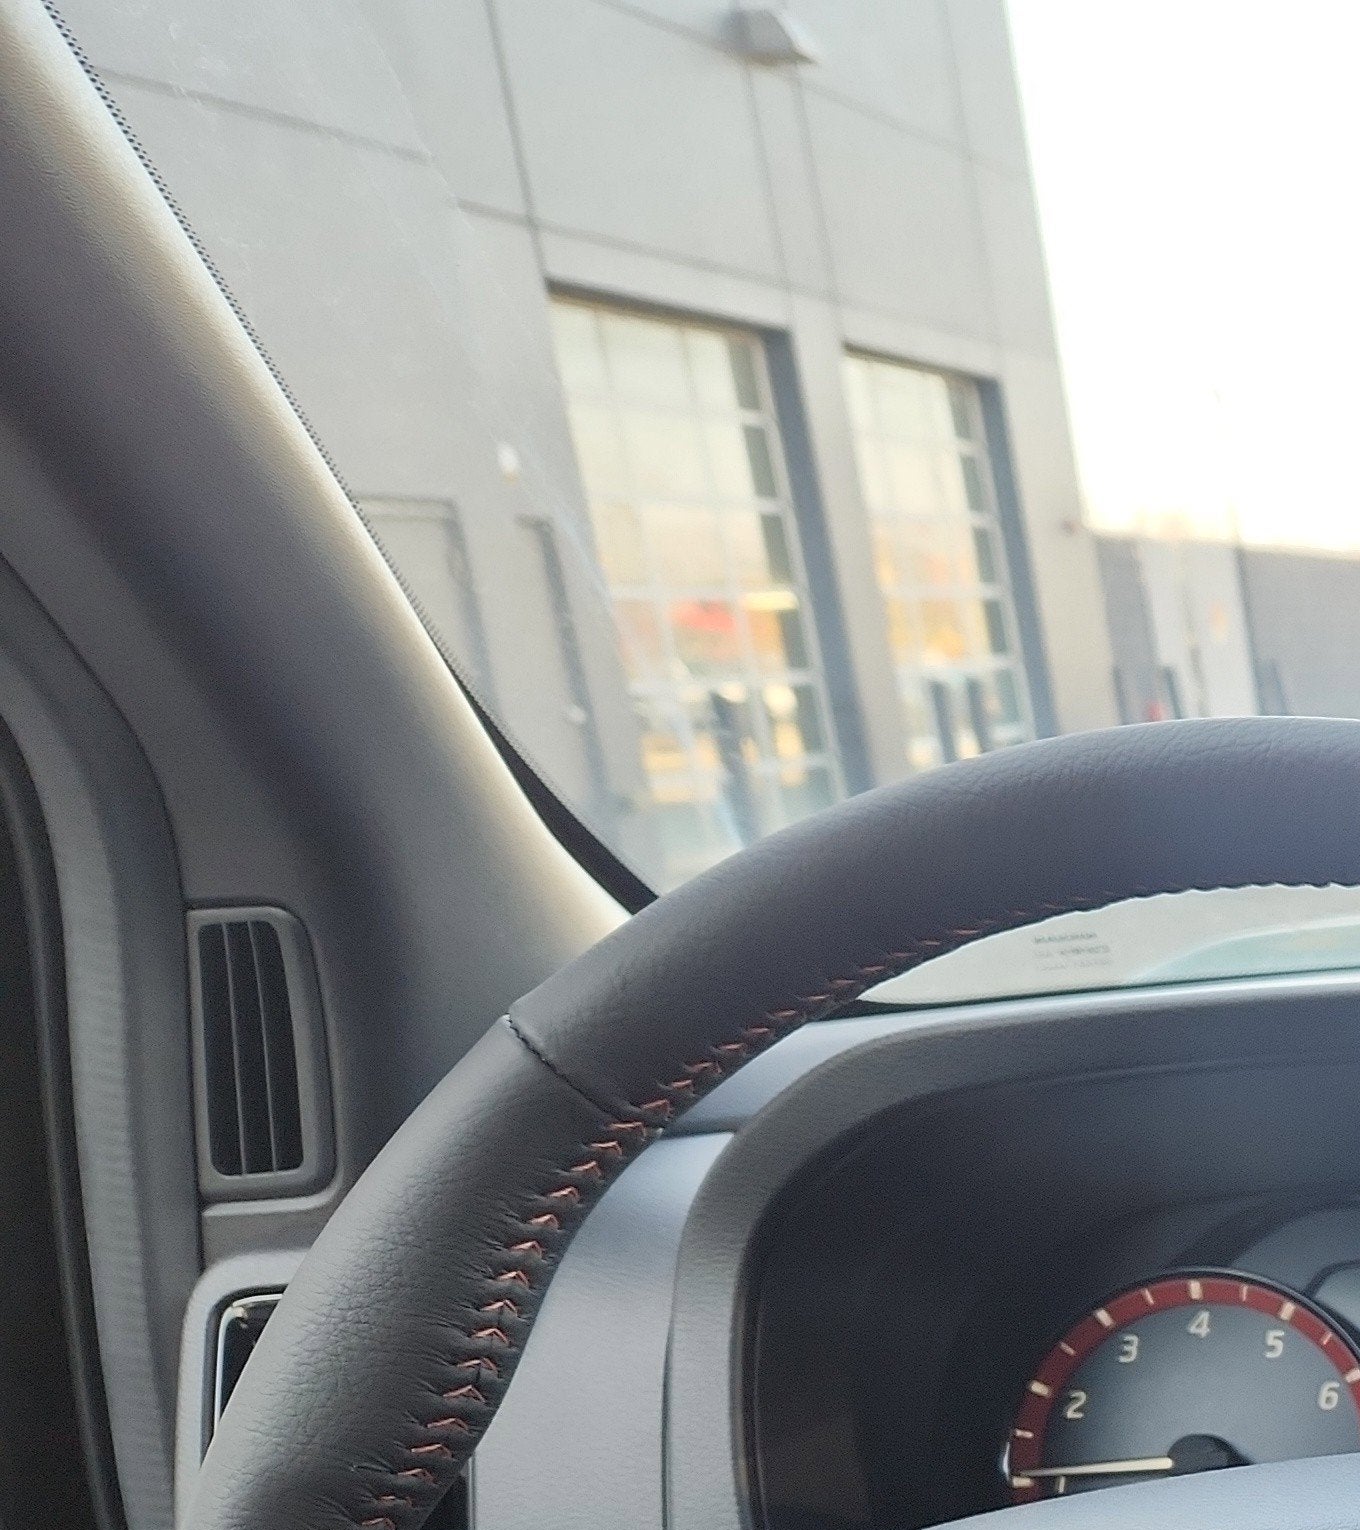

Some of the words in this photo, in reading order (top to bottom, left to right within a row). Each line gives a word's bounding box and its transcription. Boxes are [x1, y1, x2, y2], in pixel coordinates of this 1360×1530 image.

[1187, 1310, 1211, 1338] 4
[1117, 1335, 1140, 1364] 3
[1264, 1329, 1285, 1359] 5
[1064, 1391, 1088, 1419] 2
[1317, 1380, 1340, 1410] 6
